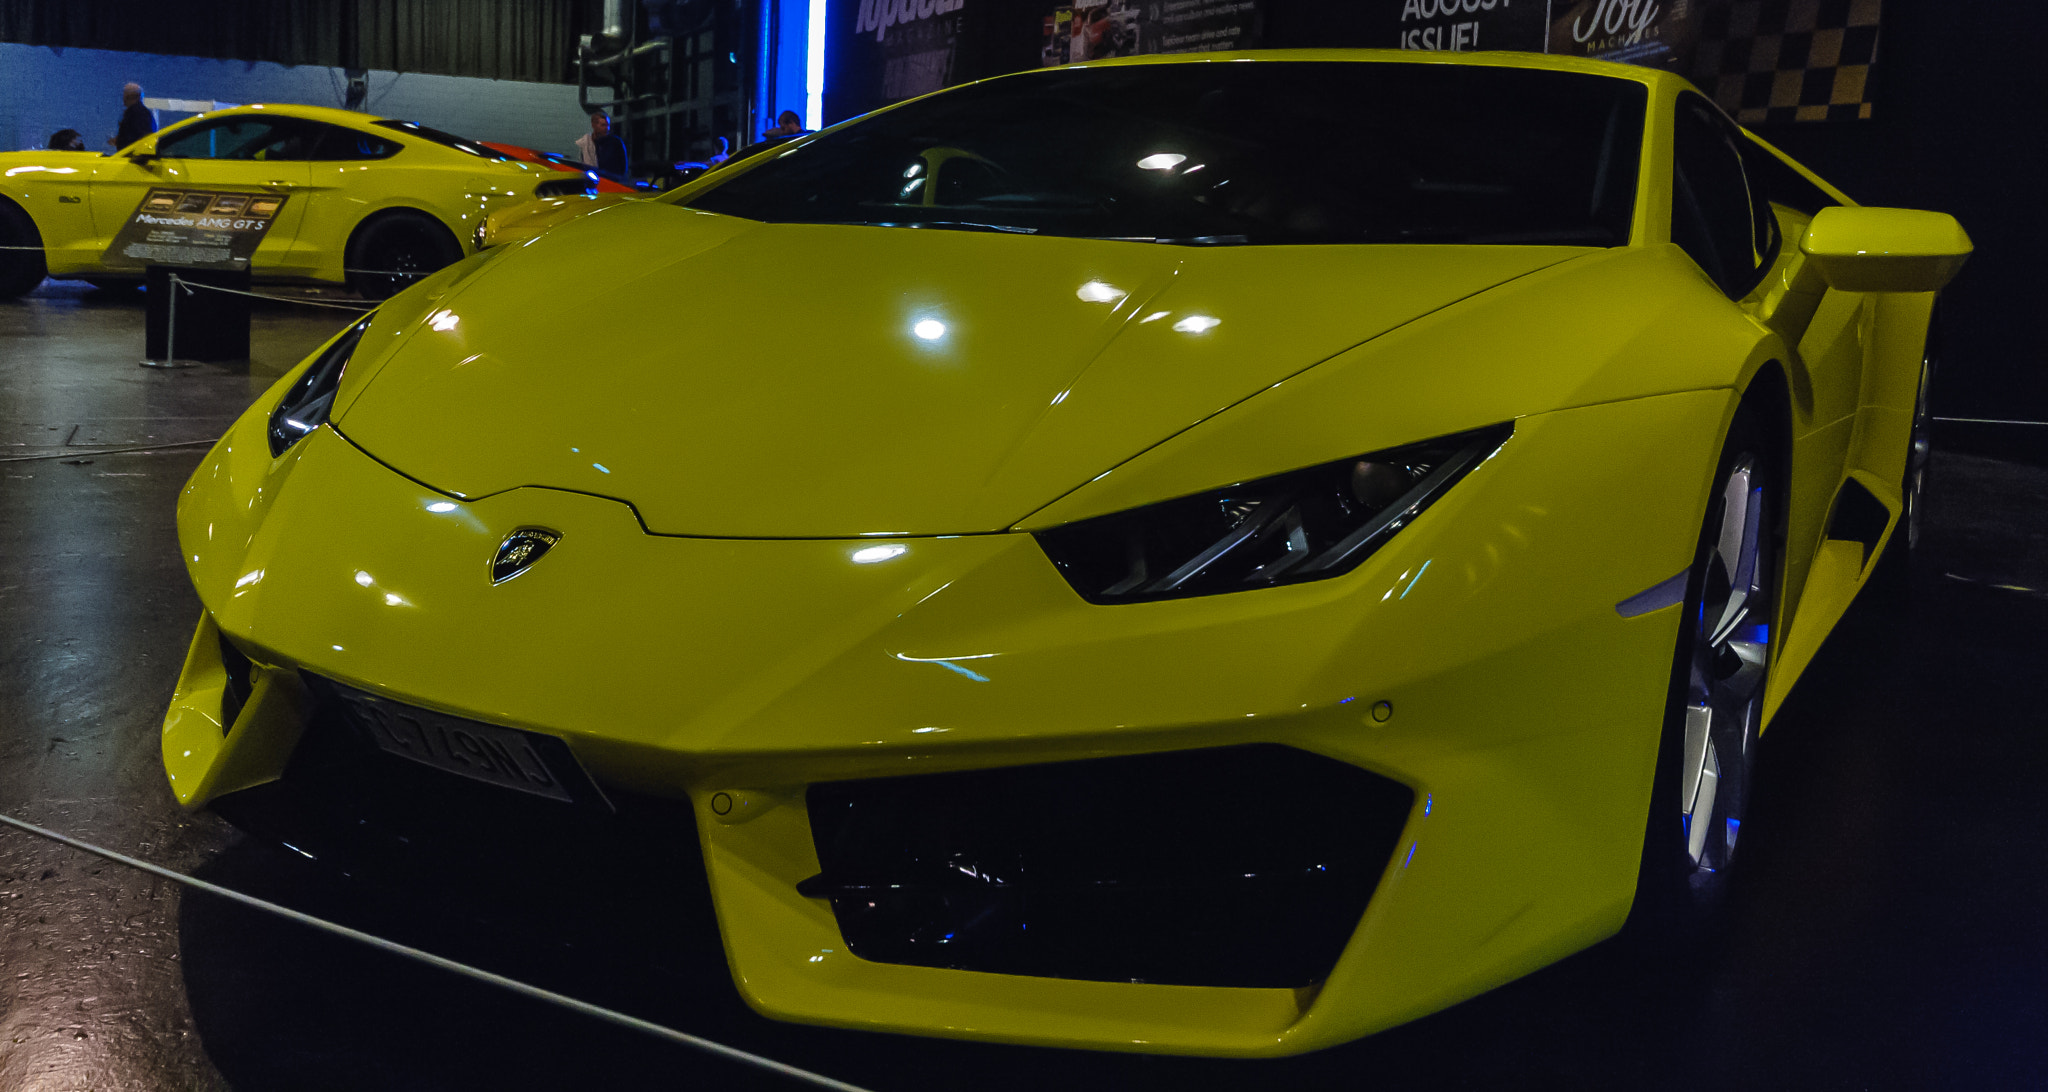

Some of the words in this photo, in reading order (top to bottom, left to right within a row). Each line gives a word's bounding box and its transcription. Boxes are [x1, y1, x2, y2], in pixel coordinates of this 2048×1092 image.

[136, 213, 195, 226] Mercedes
[196, 218, 231, 229] AMG
[233, 220, 256, 230] GT
[254, 220, 266, 231] S
